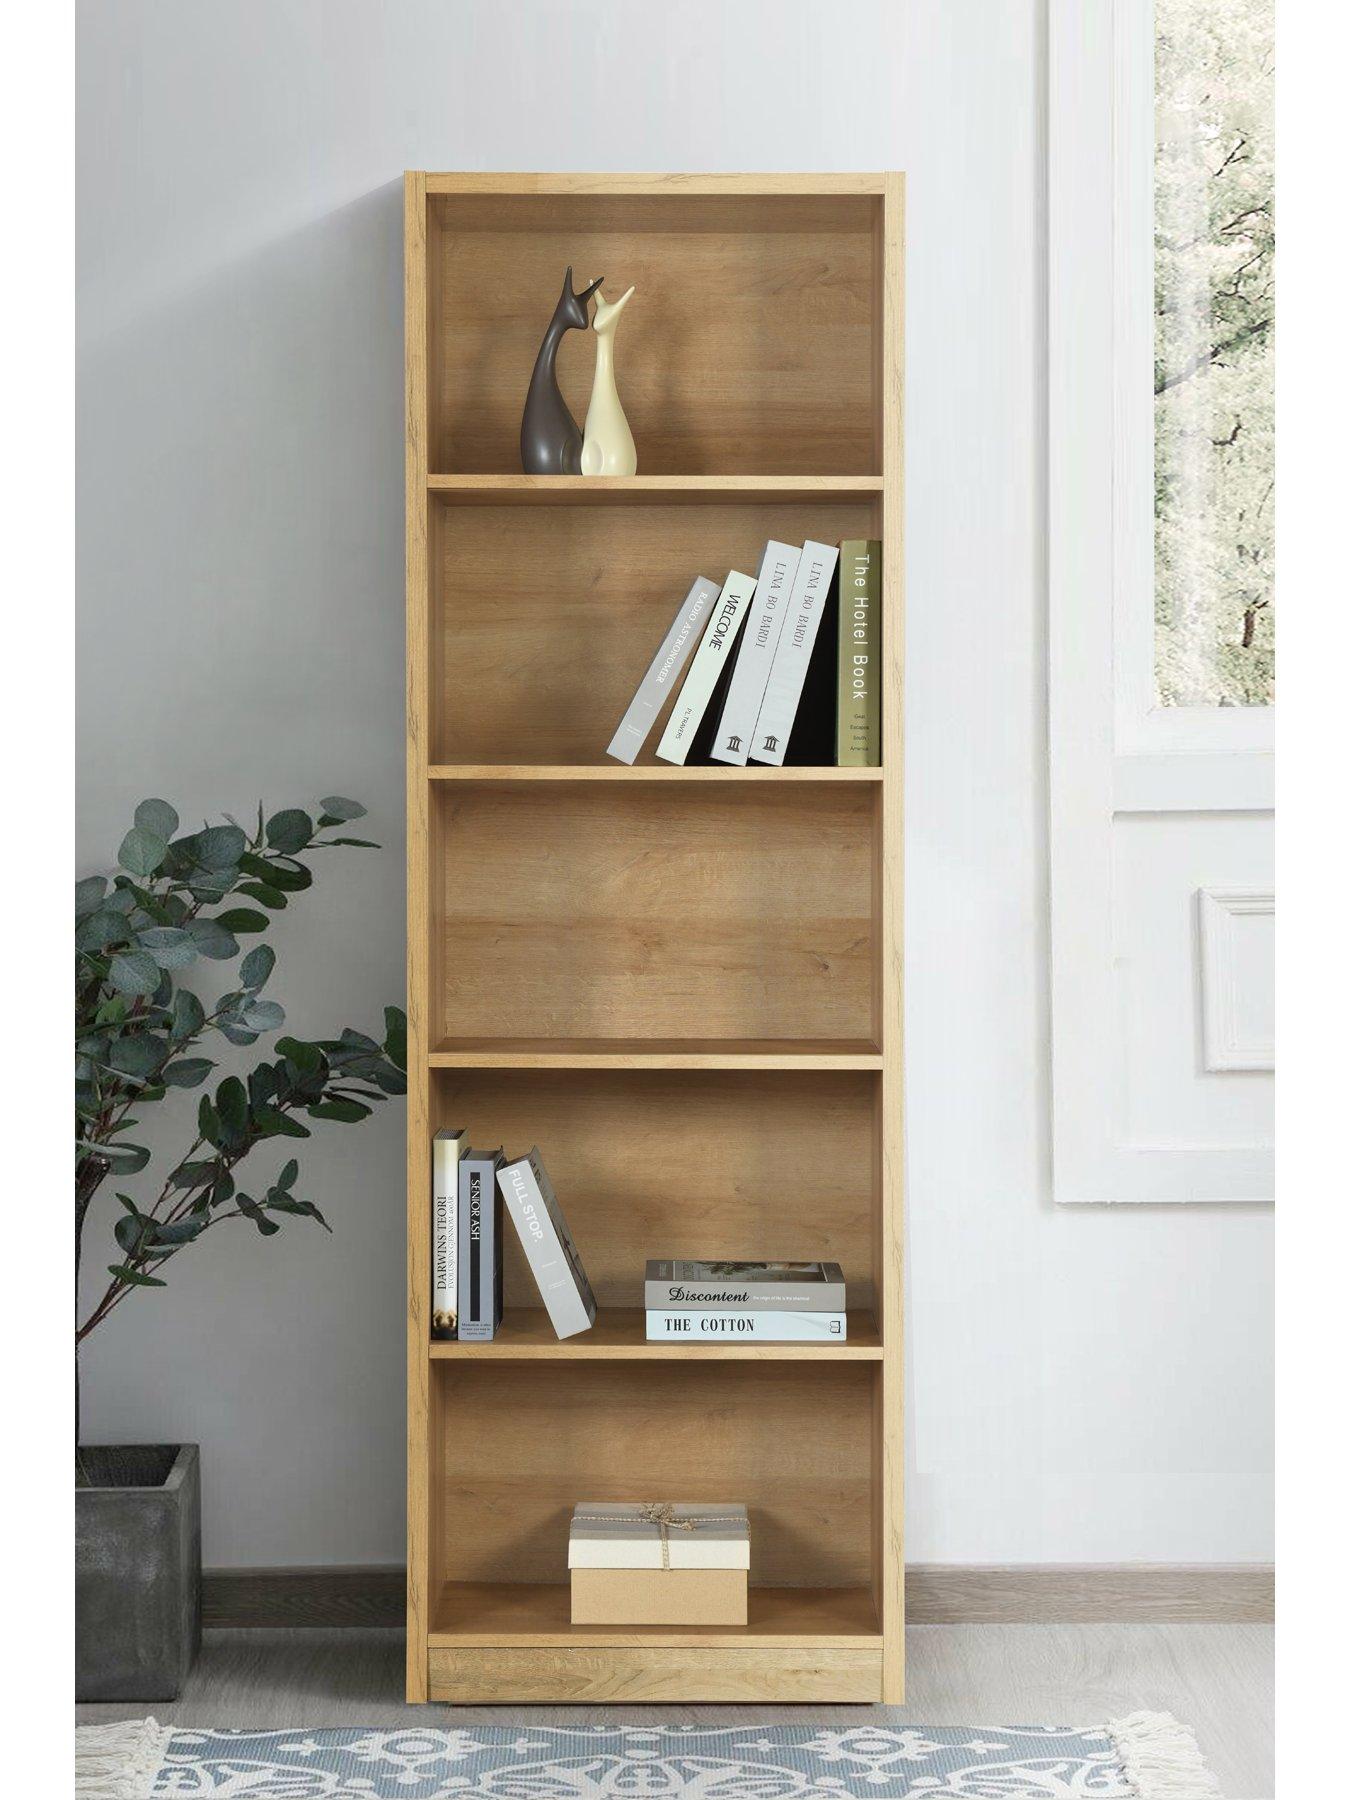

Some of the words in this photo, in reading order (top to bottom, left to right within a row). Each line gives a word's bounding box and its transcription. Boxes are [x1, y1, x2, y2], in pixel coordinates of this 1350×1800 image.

[770, 562, 787, 589] LINA
[807, 562, 823, 589] LINA
[855, 554, 870, 587] The
[688, 592, 708, 621] RADIO
[766, 595, 778, 610] BO
[802, 595, 815, 610] BO
[709, 594, 741, 651] WELCOME
[756, 615, 773, 649] BARDI
[792, 615, 809, 648] BARDI
[854, 597, 869, 645] Hotel
[656, 623, 692, 684] ASTRONOMER
[853, 655, 868, 699] Book
[437, 1196, 447, 1232] TEORI
[470, 1180, 480, 1217] SENIOR
[508, 1169, 524, 1203] FULL
[523, 1204, 544, 1243] STOP.
[470, 1219, 480, 1240] ASH
[437, 1234, 447, 1290] DARWINS
[669, 1286, 750, 1302] Discontent
[664, 1318, 691, 1332] THE
[701, 1318, 754, 1332] COTTON
